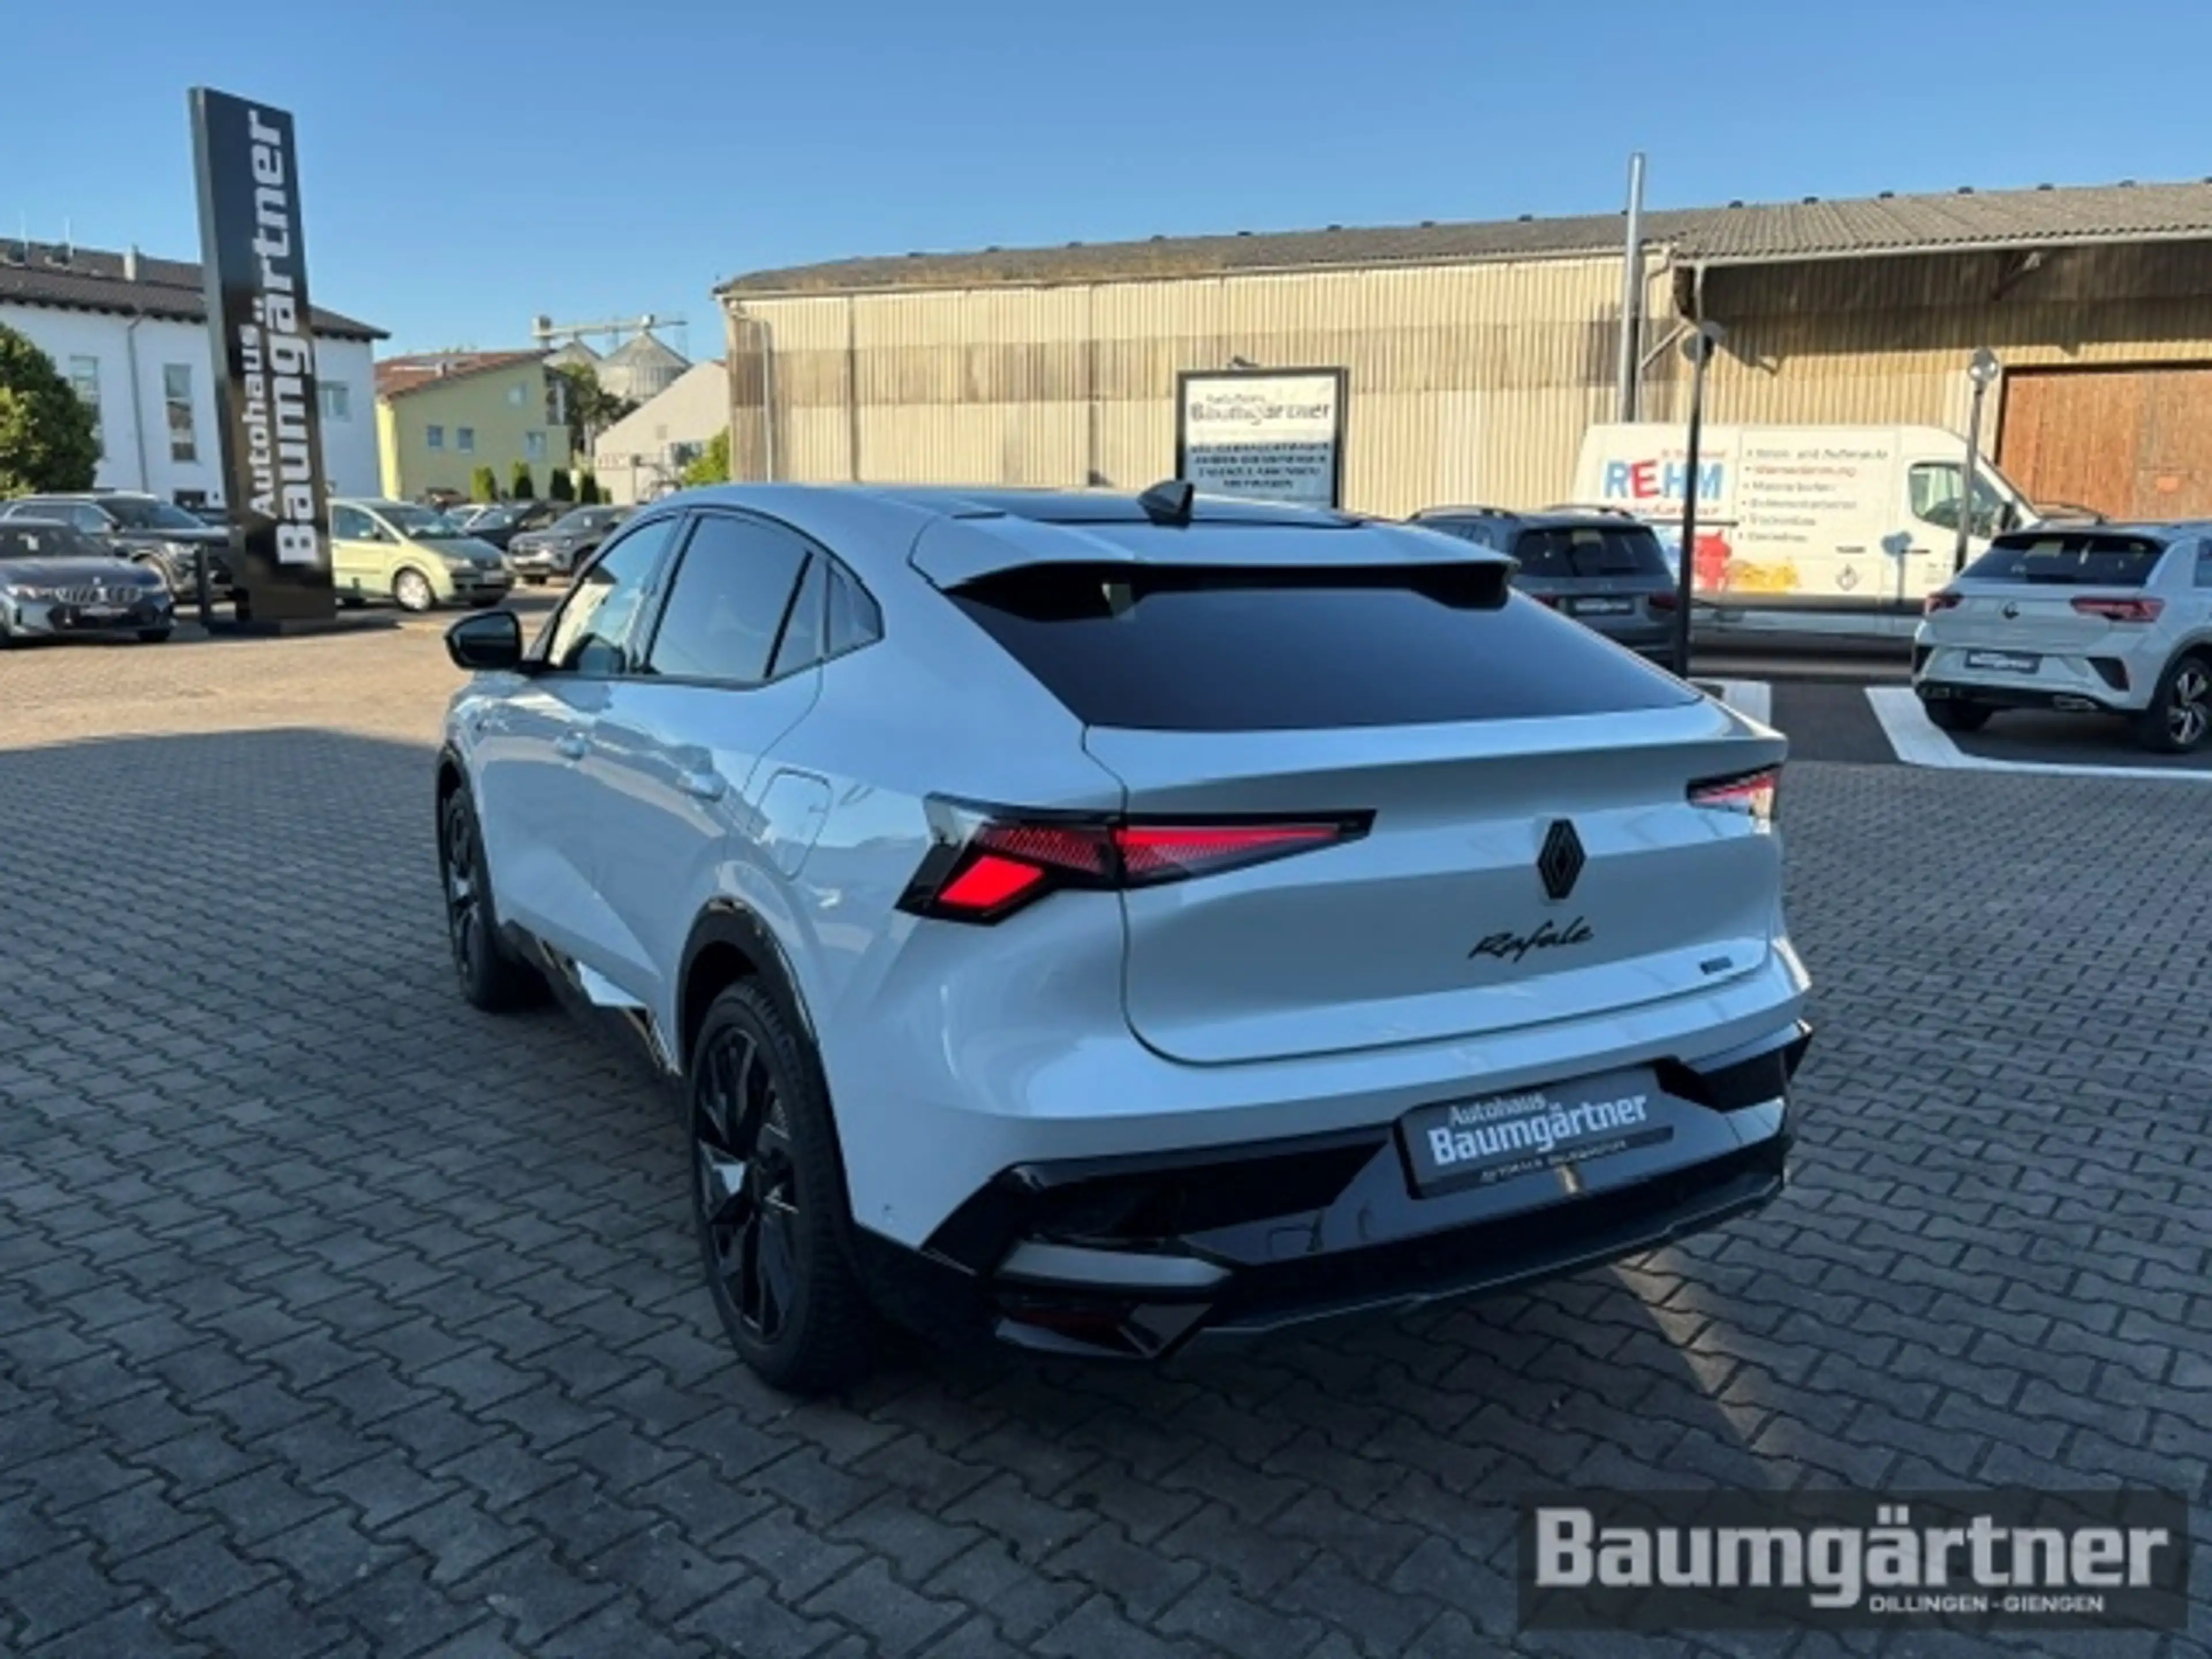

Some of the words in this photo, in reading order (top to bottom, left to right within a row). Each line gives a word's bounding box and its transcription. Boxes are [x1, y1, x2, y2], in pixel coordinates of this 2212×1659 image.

[249, 108, 319, 566] Baumgärtner
[240, 323, 278, 520] Autohaus
[1603, 459, 1724, 499] REHM
[1426, 1094, 1647, 1166] Baumgärtner
[1448, 1093, 1547, 1126] Autohaus
